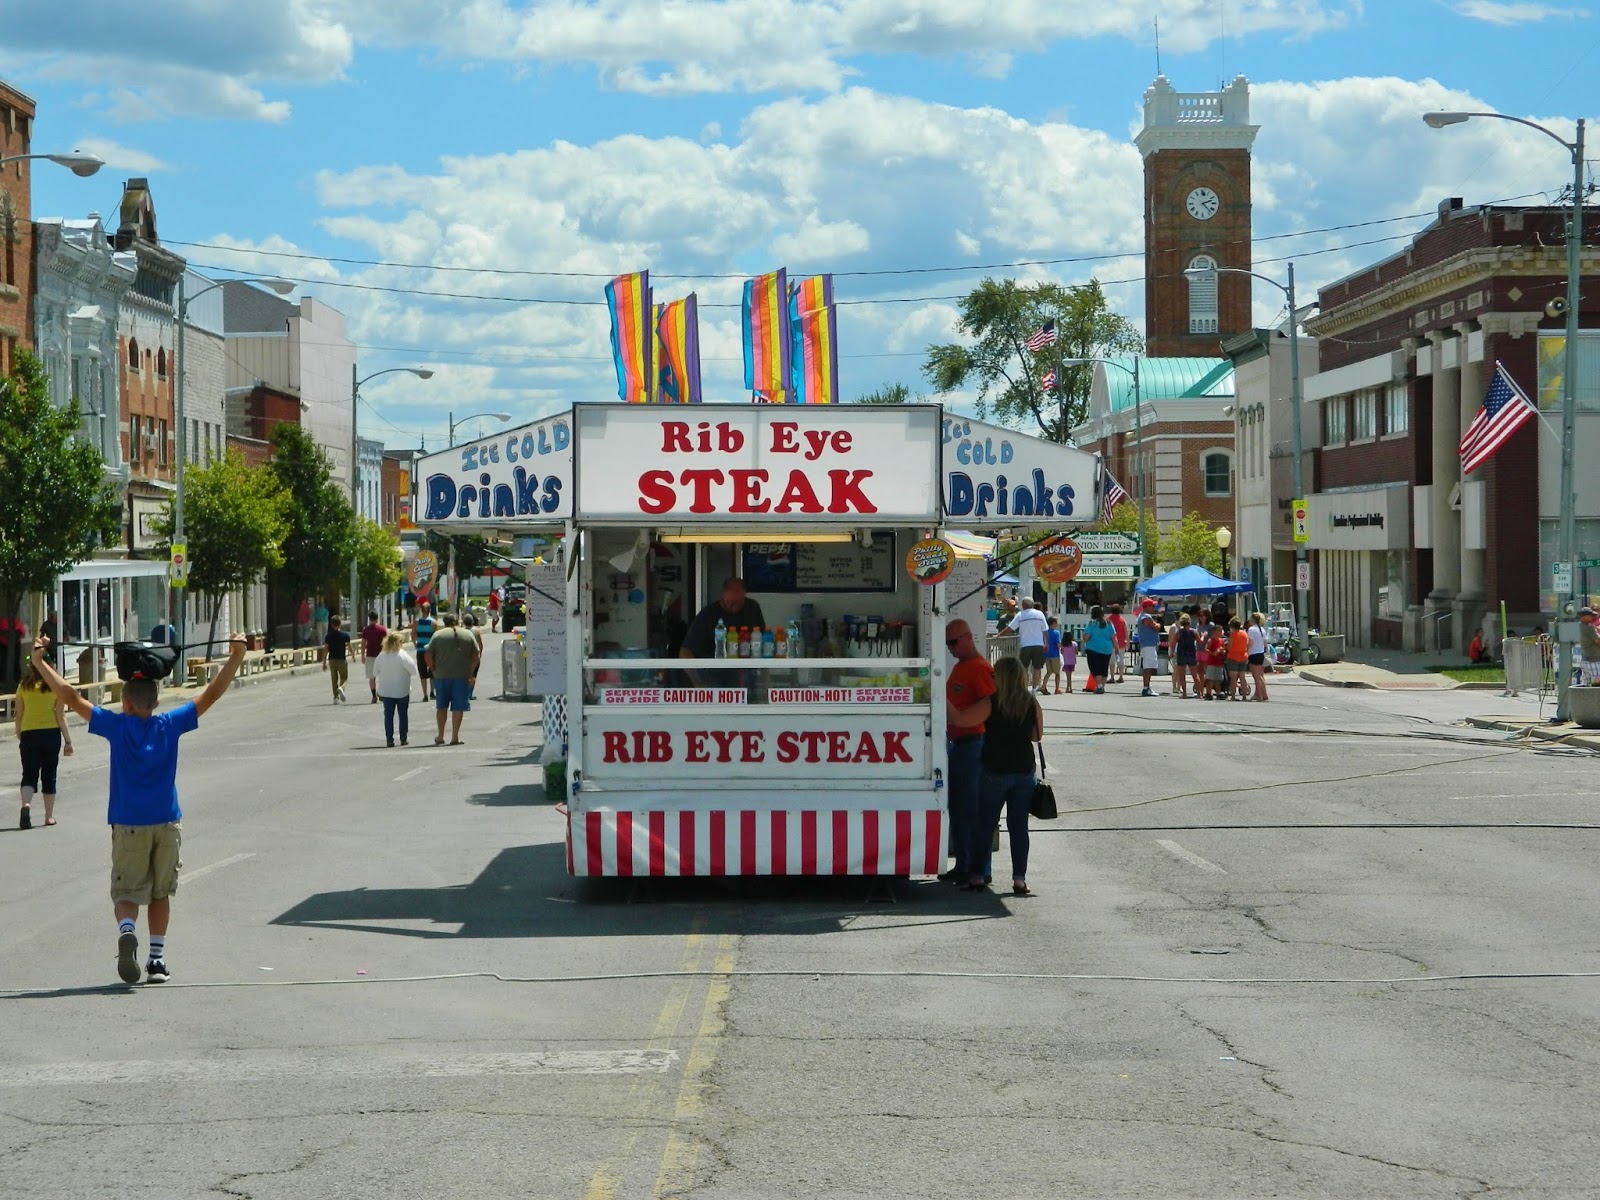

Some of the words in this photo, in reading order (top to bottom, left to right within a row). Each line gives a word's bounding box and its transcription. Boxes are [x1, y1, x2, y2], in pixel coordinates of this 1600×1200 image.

[506, 419, 570, 463] COLD
[661, 421, 745, 453] Rib
[770, 421, 853, 460] Eye
[957, 437, 1014, 465] COLD
[425, 466, 563, 519] Drinks
[638, 469, 878, 514] STEAK
[949, 468, 1076, 517] Drinks
[914, 545, 944, 555] Philly
[1038, 544, 1077, 558] SAUSAGE
[1077, 541, 1100, 550] NION
[1103, 541, 1132, 550] RINGS
[1081, 567, 1128, 575] MUSHROOMS
[547, 628, 566, 636] Drink
[664, 690, 713, 702] CAUTION
[718, 691, 745, 703] HOT!
[770, 690, 852, 702] CAUTION-HOT!
[603, 731, 674, 763] RIB
[684, 731, 765, 763] EYE
[776, 731, 914, 763] STEAK
